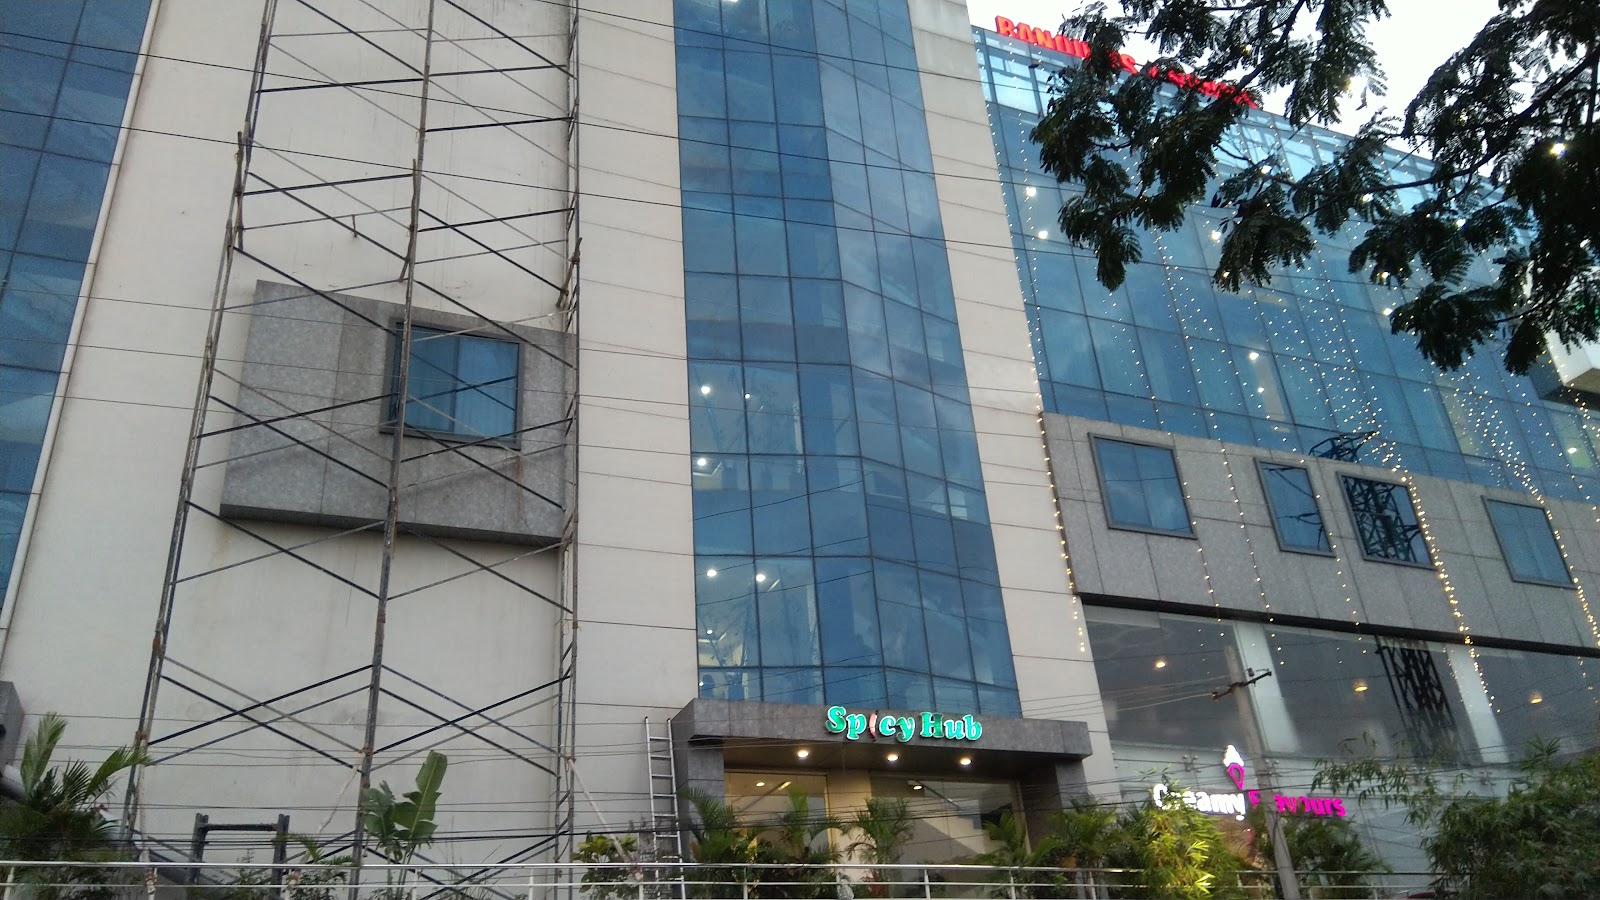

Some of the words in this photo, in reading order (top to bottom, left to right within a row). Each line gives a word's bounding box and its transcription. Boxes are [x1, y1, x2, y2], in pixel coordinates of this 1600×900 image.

[825, 705, 916, 743] Spicy
[919, 712, 983, 742] Hub
[1248, 790, 1347, 818] Favours
